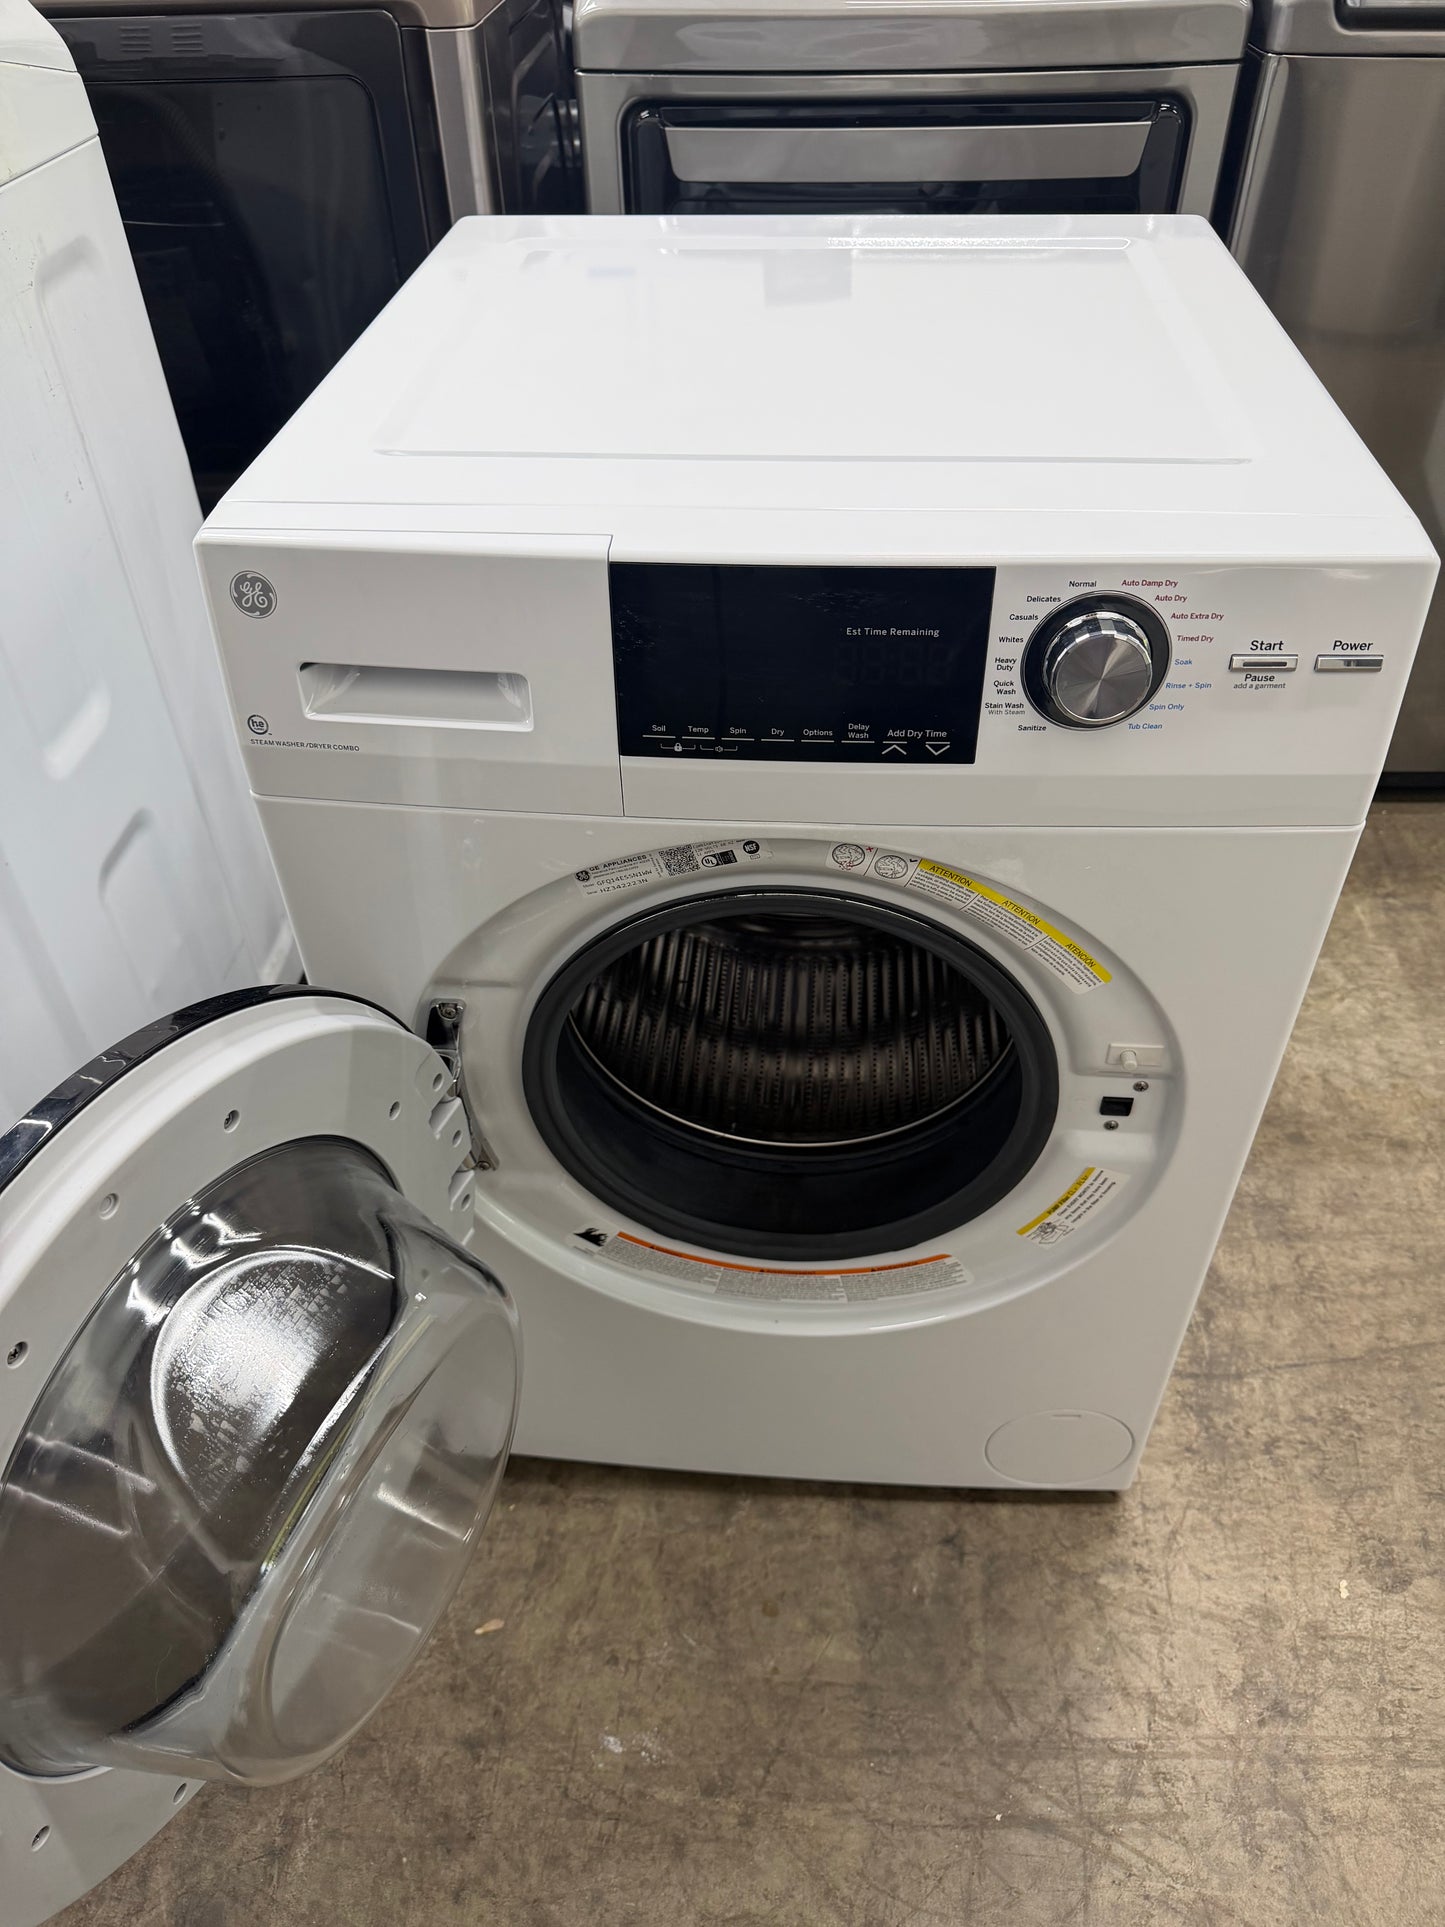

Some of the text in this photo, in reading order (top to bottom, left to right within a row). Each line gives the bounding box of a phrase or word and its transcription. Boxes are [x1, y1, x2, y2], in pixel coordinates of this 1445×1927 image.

[1068, 580, 1097, 588] Normal
[1121, 579, 1178, 589] Auto Damp Dry
[1026, 595, 1062, 603] Delicates
[1154, 594, 1188, 603] Auto Dry
[1009, 613, 1039, 621] Casuals
[1170, 612, 1225, 622] Auto Extra Dry
[846, 627, 940, 638] Est Time Remaining
[1176, 634, 1214, 644] Timed Dry
[1250, 639, 1284, 651] Start
[1332, 639, 1373, 651] Power
[994, 656, 1017, 665] Heavy
[1174, 658, 1193, 666] Soak
[996, 664, 1014, 672] Duty
[1244, 673, 1275, 682] Pause
[993, 680, 1015, 688] Quick
[1165, 681, 1186, 689] Rinse
[1194, 681, 1212, 690] Spin
[1254, 683, 1286, 691] garment
[1149, 703, 1185, 712] Spin Only
[652, 724, 666, 732] Soil
[688, 725, 709, 733] Temp
[729, 726, 747, 735] Spin
[848, 723, 870, 731] Delay
[1018, 724, 1047, 732] Sanitize
[1142, 722, 1163, 730] Clean
[771, 728, 785, 736] Dry
[802, 728, 833, 737] Options
[848, 731, 869, 739] Wash
[887, 729, 947, 739] Add Dry Time
[250, 738, 275, 746] STEAM
[333, 744, 360, 752] COMBO
[603, 854, 647, 868] APPLIANCES
[930, 865, 973, 887] ATTENTION
[1001, 900, 1040, 925] ATTENTION
[1065, 943, 1096, 968] ATENCIÓN
